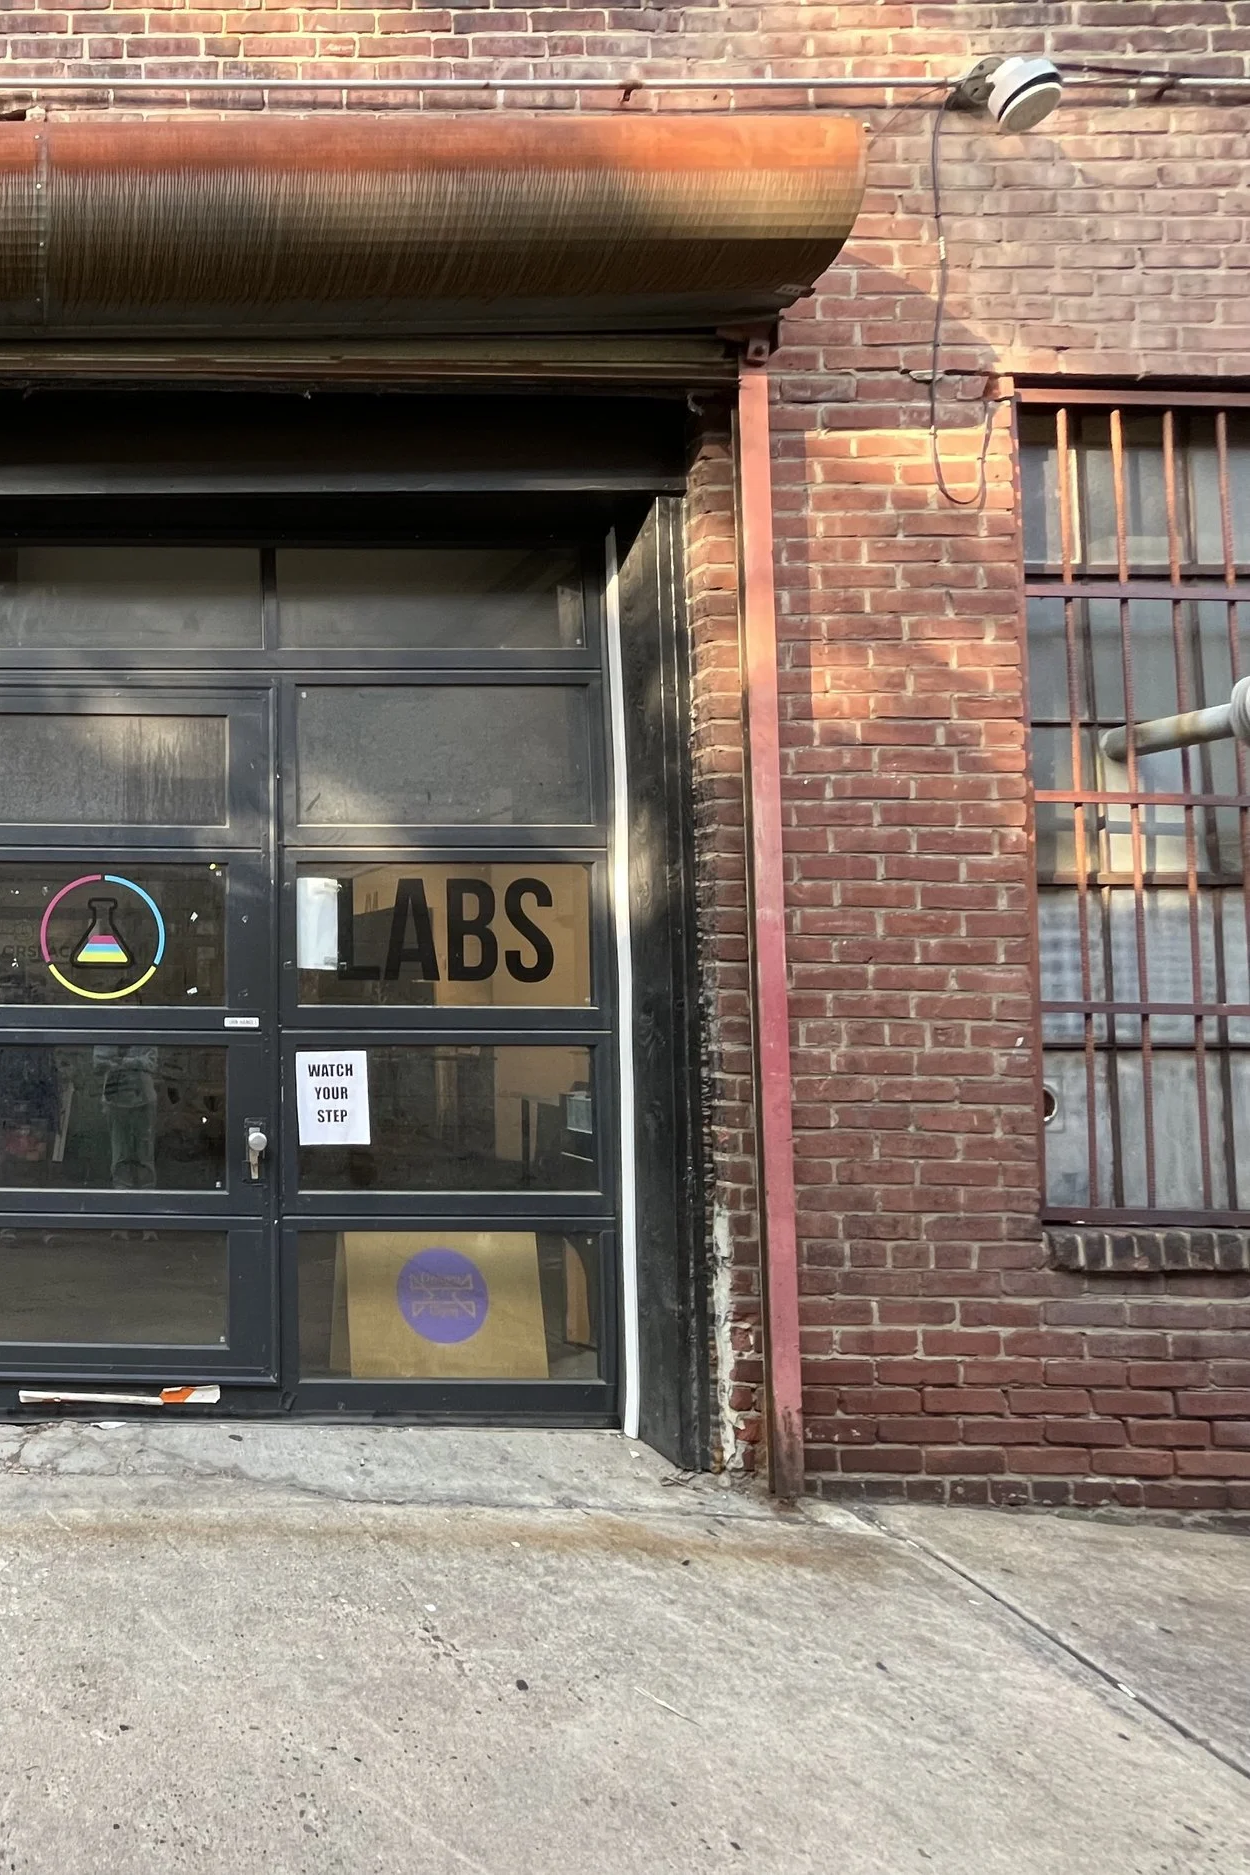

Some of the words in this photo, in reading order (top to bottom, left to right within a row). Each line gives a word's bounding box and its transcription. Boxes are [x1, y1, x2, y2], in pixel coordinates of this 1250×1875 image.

[336, 878, 554, 983] LABS
[308, 1063, 353, 1077] WATCH
[314, 1086, 348, 1100] YOUR
[317, 1109, 348, 1123] STEP
